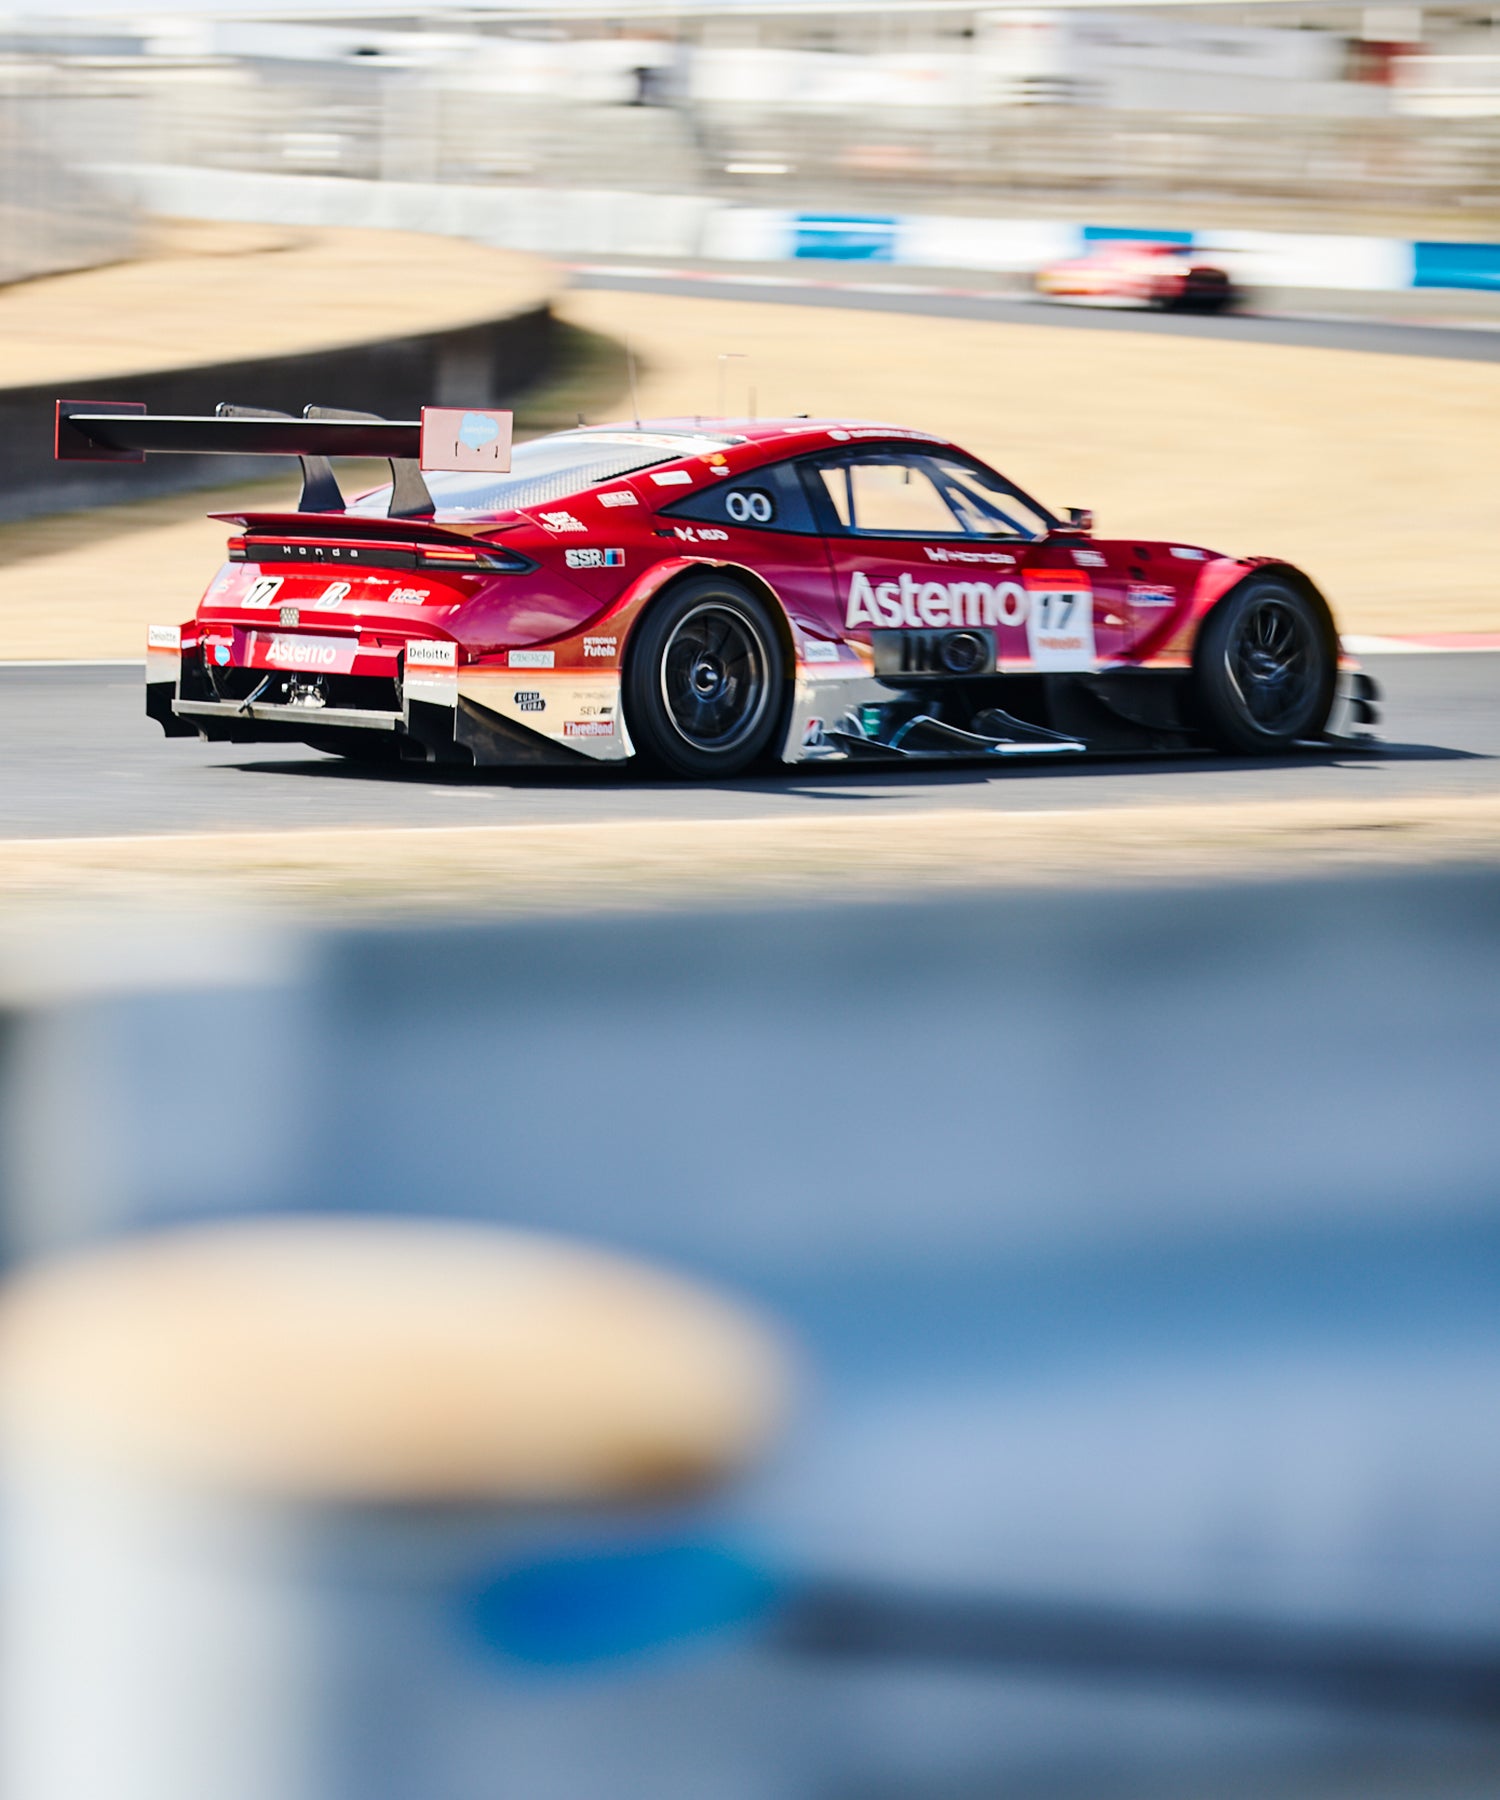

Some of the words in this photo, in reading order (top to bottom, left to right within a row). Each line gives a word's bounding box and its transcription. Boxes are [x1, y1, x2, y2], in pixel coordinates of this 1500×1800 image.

[283, 546, 358, 558] Honda
[565, 549, 604, 569] SSR
[247, 582, 278, 604] 17
[845, 571, 1029, 628] Astemo
[1040, 594, 1076, 630] 17
[583, 636, 617, 645] PETRONAS
[265, 639, 336, 664] Astemo
[409, 648, 451, 659] Deloitte
[565, 722, 613, 735] ThreeBond
